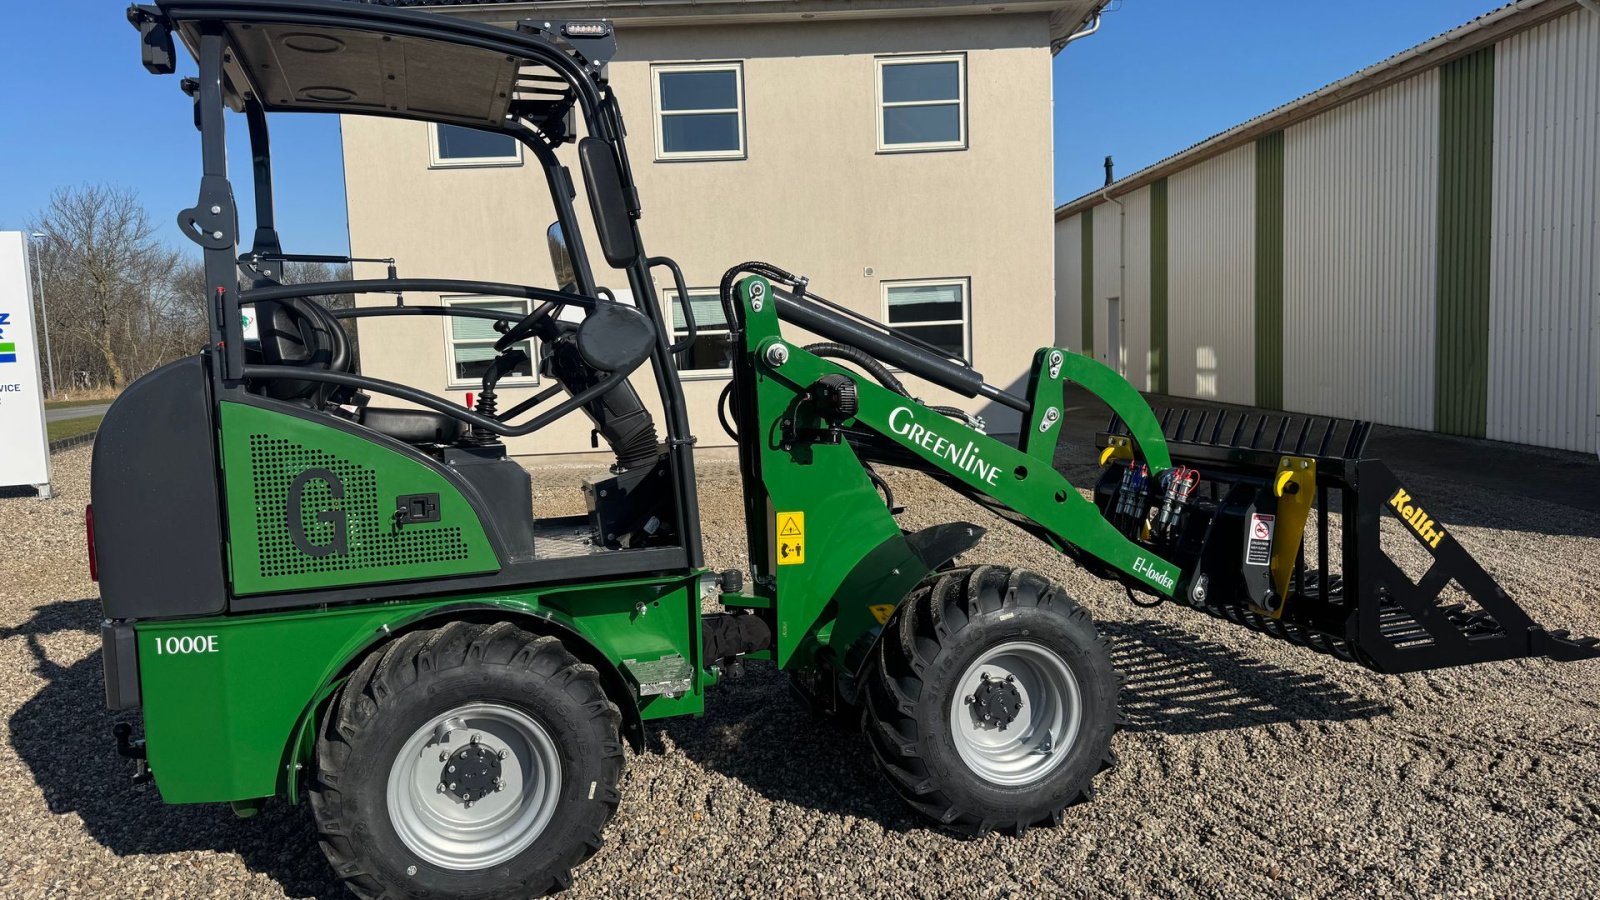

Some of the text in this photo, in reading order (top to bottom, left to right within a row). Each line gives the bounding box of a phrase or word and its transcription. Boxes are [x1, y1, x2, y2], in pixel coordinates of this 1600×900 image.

[286, 468, 349, 557] G
[1390, 488, 1444, 548] Kellfri
[155, 635, 219, 655] 1000E
